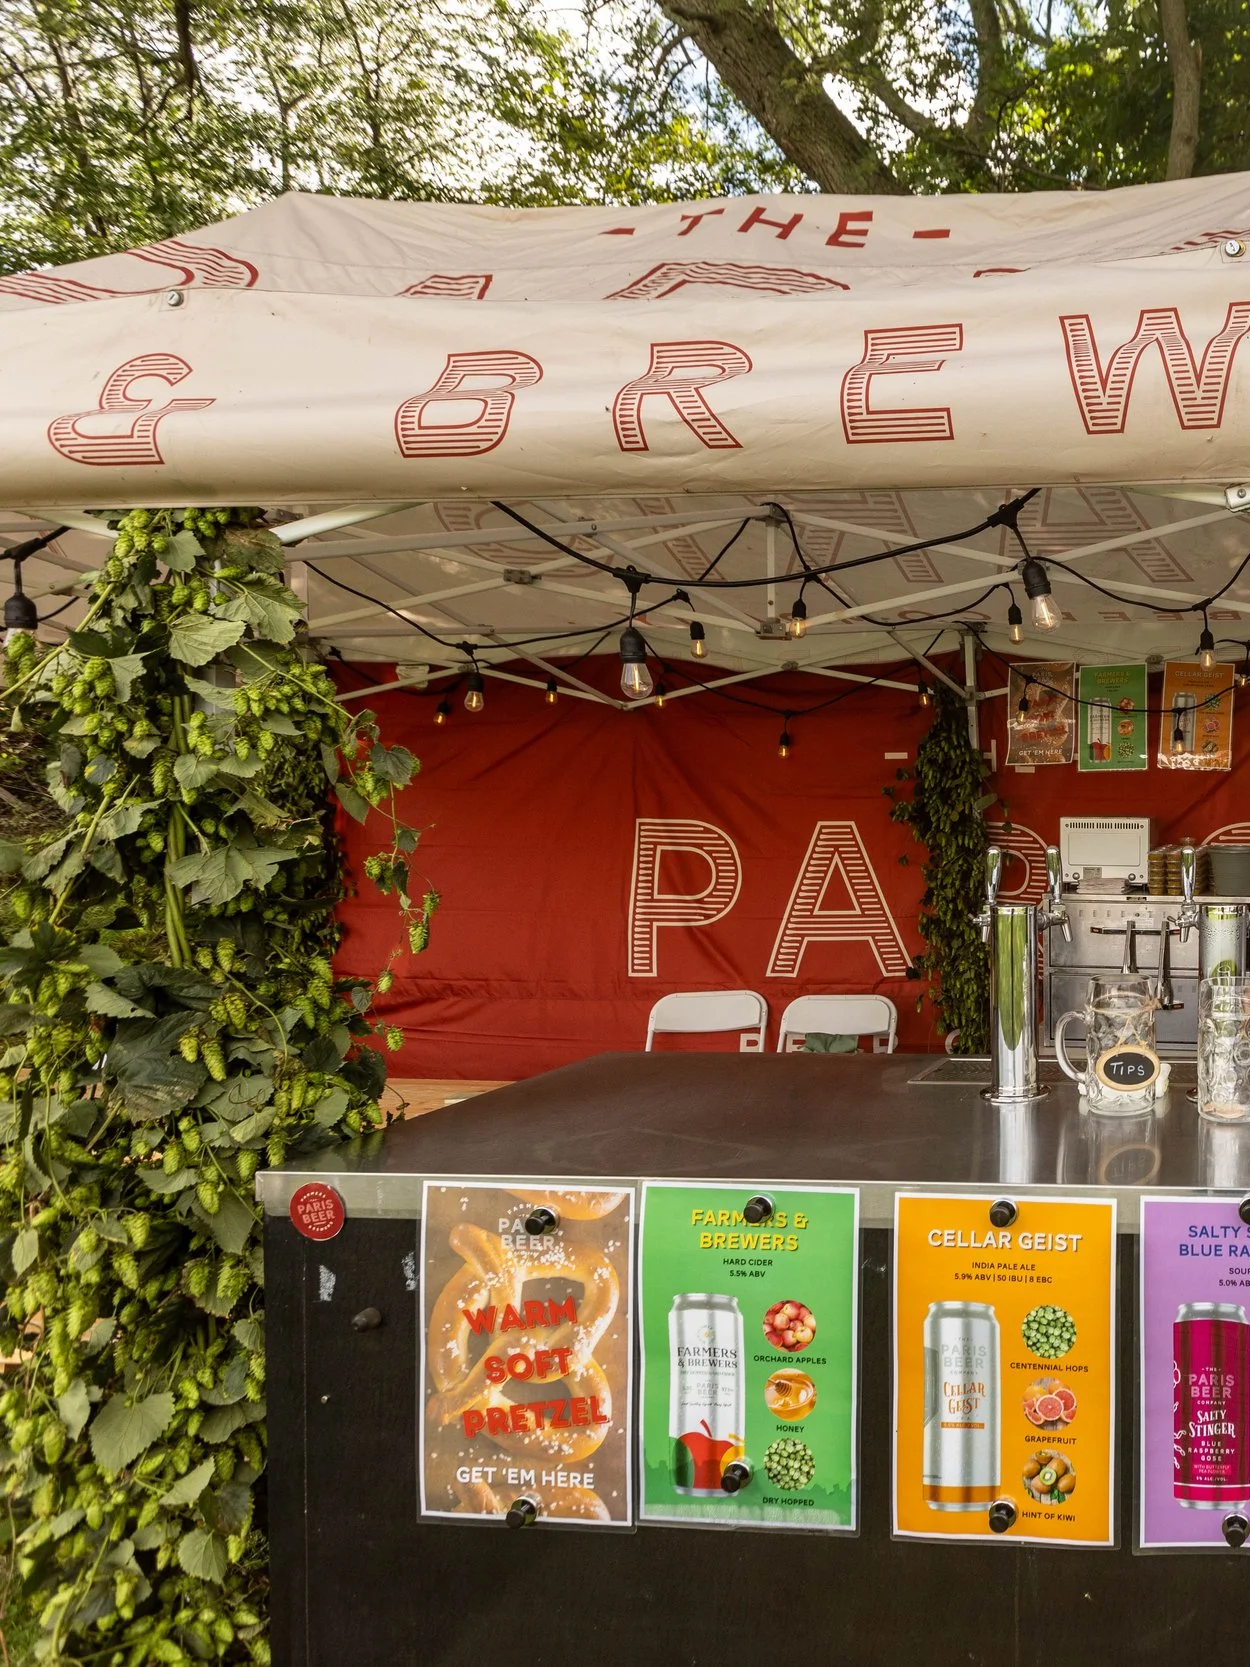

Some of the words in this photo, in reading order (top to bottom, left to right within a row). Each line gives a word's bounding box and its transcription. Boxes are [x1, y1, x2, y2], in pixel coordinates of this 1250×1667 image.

[47, 352, 215, 466] &
[1110, 1061, 1145, 1076] TIPS
[297, 1199, 335, 1215] PARIS
[302, 1210, 336, 1224] BEER
[793, 1212, 809, 1229] &
[1188, 1225, 1242, 1239] SALTY
[501, 1234, 555, 1250] BEER
[699, 1231, 799, 1251] BREWERS
[927, 1229, 1012, 1250] CELLAR
[1017, 1232, 1083, 1252] GEIST
[1179, 1244, 1223, 1257] BLUE
[723, 1257, 747, 1266] HARD
[748, 1258, 774, 1267] CIDER
[971, 1262, 995, 1270] INDIA
[997, 1263, 1018, 1271] PALE
[1020, 1263, 1036, 1271] ALE
[729, 1269, 747, 1278] 5.5%
[749, 1270, 766, 1278] ABV
[954, 1272, 973, 1281] 5.9%
[974, 1273, 992, 1281] ABV
[997, 1274, 1007, 1282] 50
[1008, 1274, 1023, 1283] IBU
[1029, 1275, 1035, 1283] 8
[1036, 1275, 1053, 1284] EBC
[1218, 1279, 1238, 1287] 5.0%
[462, 1296, 577, 1336] WARM
[677, 1346, 738, 1360] FARMERS
[942, 1343, 987, 1357] PARIS
[484, 1347, 574, 1385] SOFT
[677, 1359, 685, 1367] &
[687, 1358, 738, 1369] BREWERS
[753, 1355, 794, 1364] ORCHARD
[796, 1356, 827, 1365] APPLES
[943, 1356, 984, 1369] BEER
[1010, 1362, 1063, 1372] CENTENNIAL
[1065, 1364, 1089, 1373] HOPS
[1188, 1373, 1235, 1387] PARIS
[943, 1381, 986, 1397] CELLAR
[1190, 1386, 1232, 1399] BEER
[948, 1397, 981, 1415] GEIST
[462, 1396, 610, 1440] PRETZEL
[1197, 1409, 1227, 1423] SALTY
[776, 1424, 805, 1433] HONEY
[1188, 1421, 1236, 1438] STINGER
[1024, 1435, 1077, 1445] GRAPEFRUIT
[1201, 1440, 1222, 1448] BLUE
[1188, 1447, 1235, 1455] RASPBERRY
[456, 1466, 497, 1485] GET
[541, 1471, 595, 1489] HERE
[762, 1496, 779, 1505] DRY
[781, 1497, 815, 1507] HOPPED
[1022, 1511, 1042, 1520] HINT
[1044, 1512, 1056, 1521] OF
[1057, 1513, 1076, 1522] KIWI
